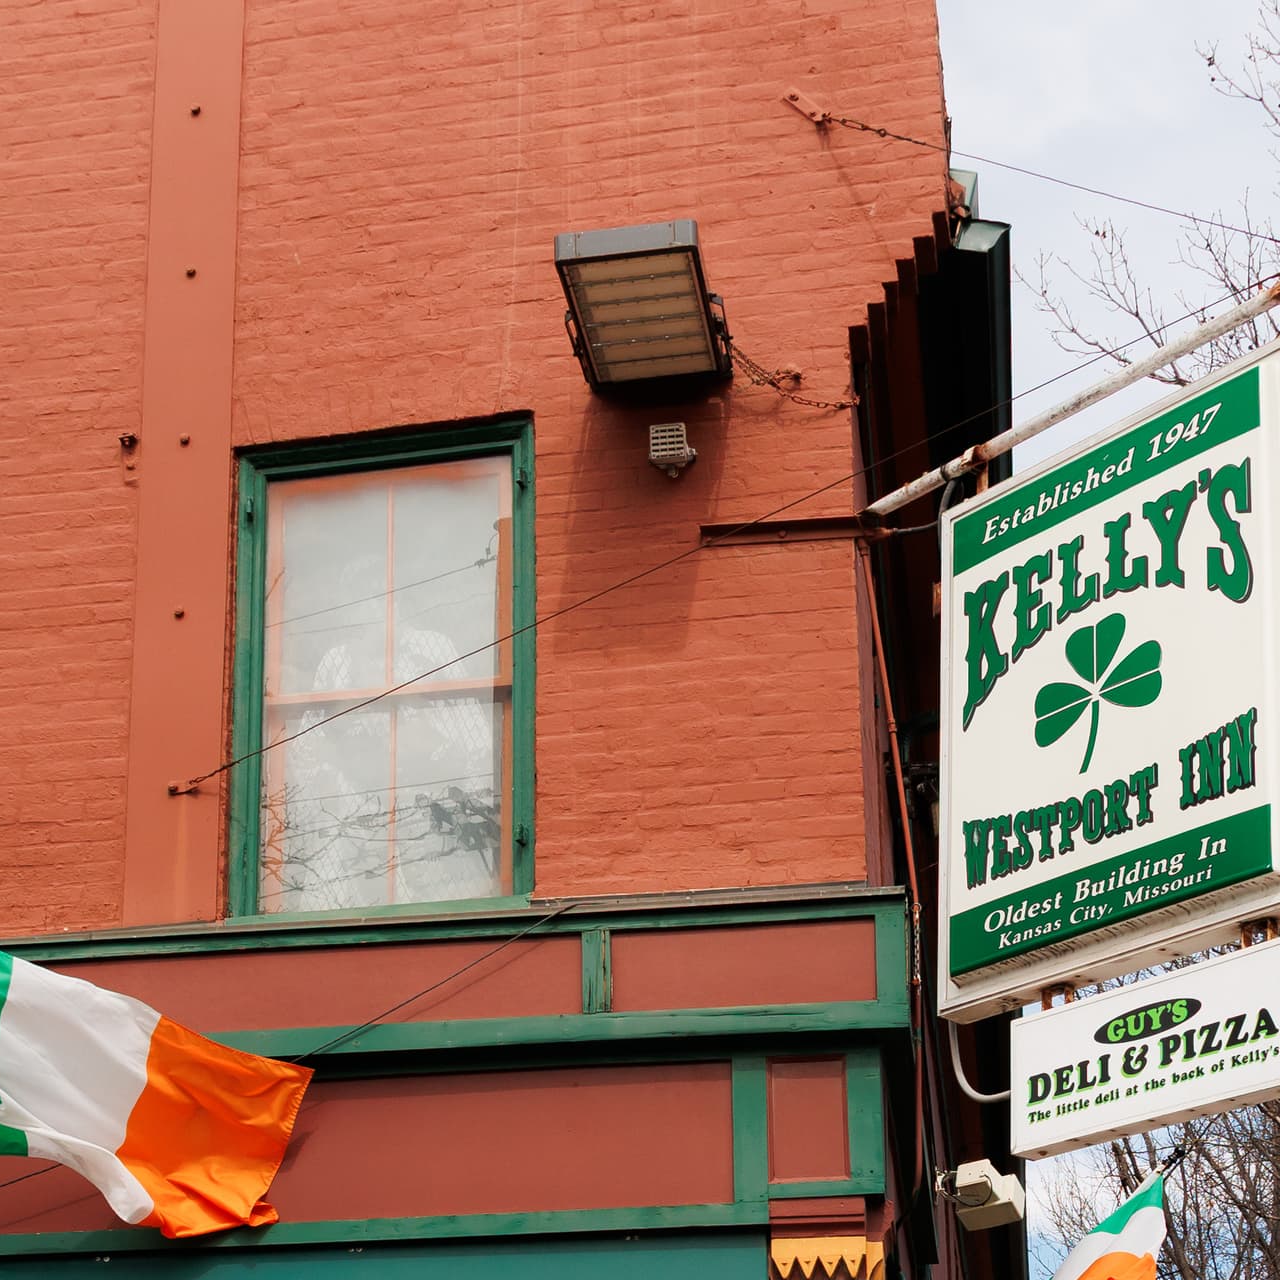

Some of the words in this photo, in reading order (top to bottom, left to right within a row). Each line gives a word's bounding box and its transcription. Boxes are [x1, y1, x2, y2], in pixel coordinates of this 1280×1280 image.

[981, 446, 1135, 545] Established
[1145, 402, 1222, 463] 1947
[962, 456, 1254, 733] KELLY'S
[962, 762, 1159, 890] WESTPORT
[1178, 706, 1258, 811] INN
[983, 891, 1063, 933] Oldest
[1072, 852, 1185, 904] Building
[1198, 836, 1228, 861] In
[997, 918, 1062, 950] Kansas
[1069, 902, 1114, 925] City,
[1122, 865, 1213, 908] Missouri
[1027, 1053, 1112, 1107] DELI
[1121, 1043, 1149, 1078] &
[1157, 1007, 1280, 1070] PIZZA
[1106, 999, 1189, 1043] GUY'S
[1028, 1109, 1052, 1126] The
[1056, 1097, 1090, 1116] little
[1094, 1089, 1121, 1106] deli
[1125, 1084, 1139, 1098] at
[1144, 1077, 1166, 1093] the
[1171, 1065, 1205, 1085] back
[1210, 1059, 1226, 1074] of
[1230, 1044, 1280, 1068] Kelly's
